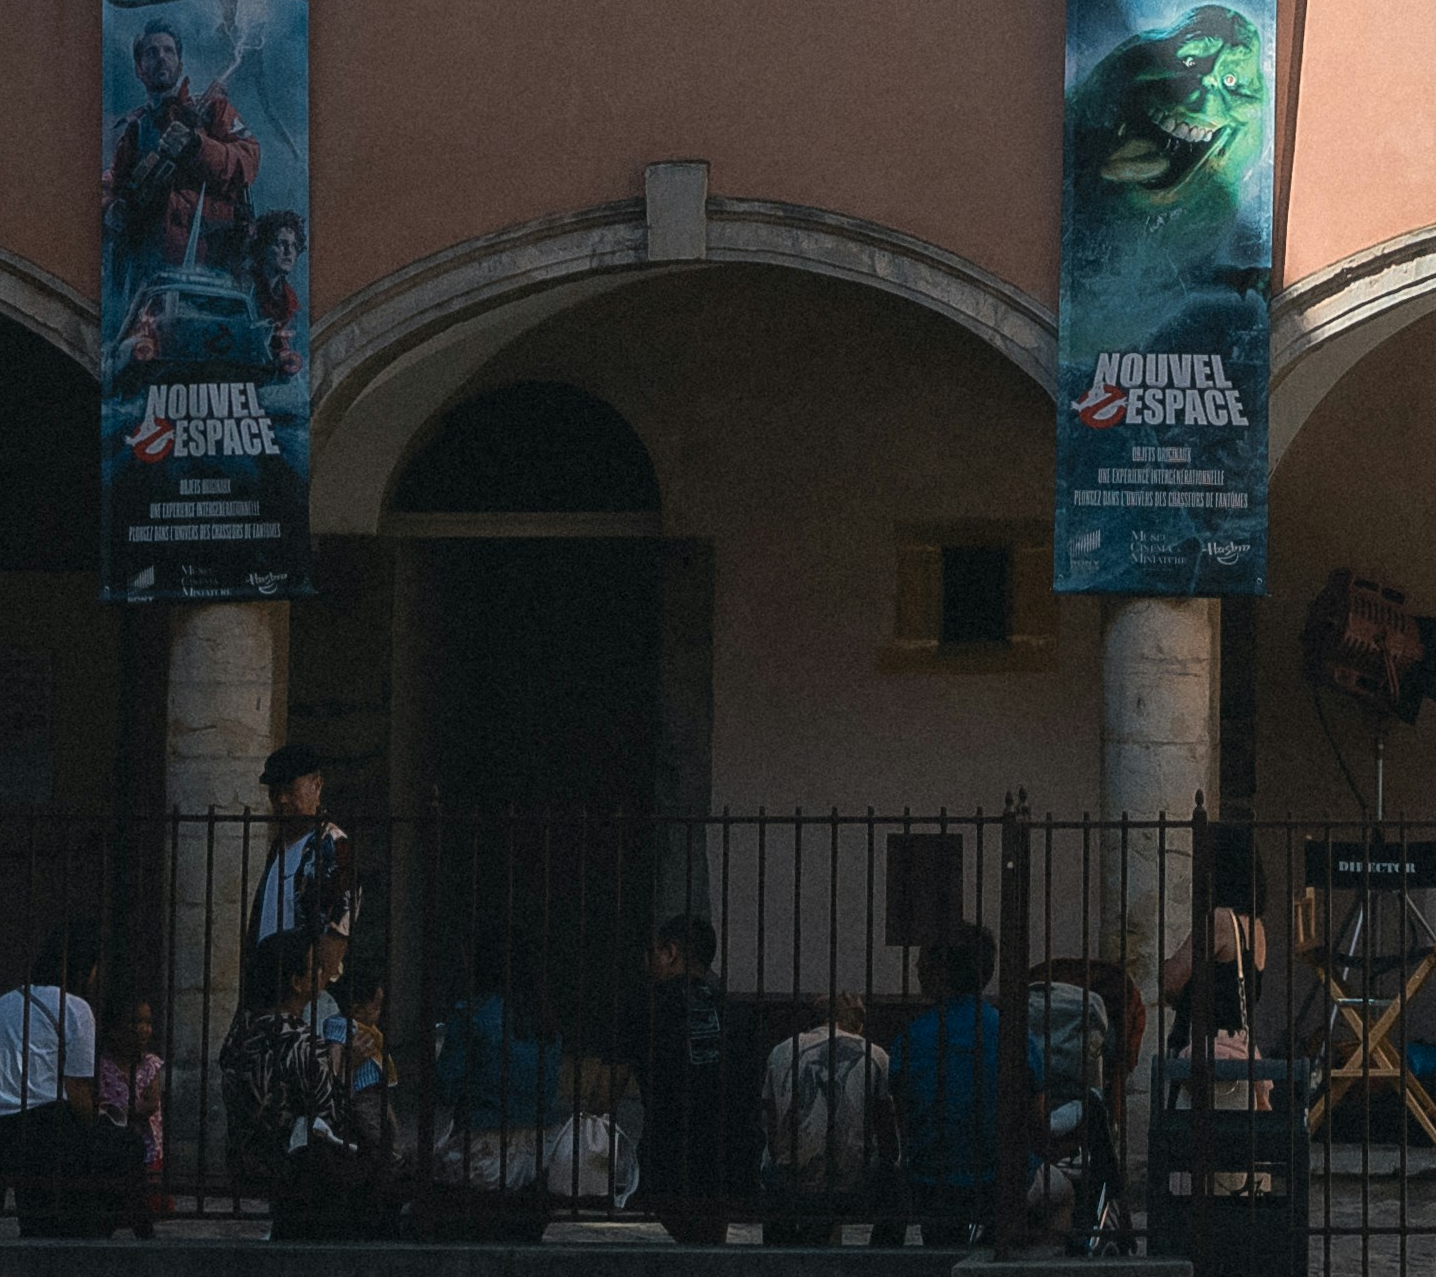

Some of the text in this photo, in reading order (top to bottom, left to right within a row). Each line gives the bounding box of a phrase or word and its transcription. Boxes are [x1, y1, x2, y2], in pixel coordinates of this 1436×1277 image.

[1093, 352, 1232, 389] NOUVEL
[145, 382, 266, 419] NOUVEL
[1125, 388, 1249, 426] ESPACE
[173, 417, 281, 457] ESPACE
[1155, 491, 1166, 506] DES
